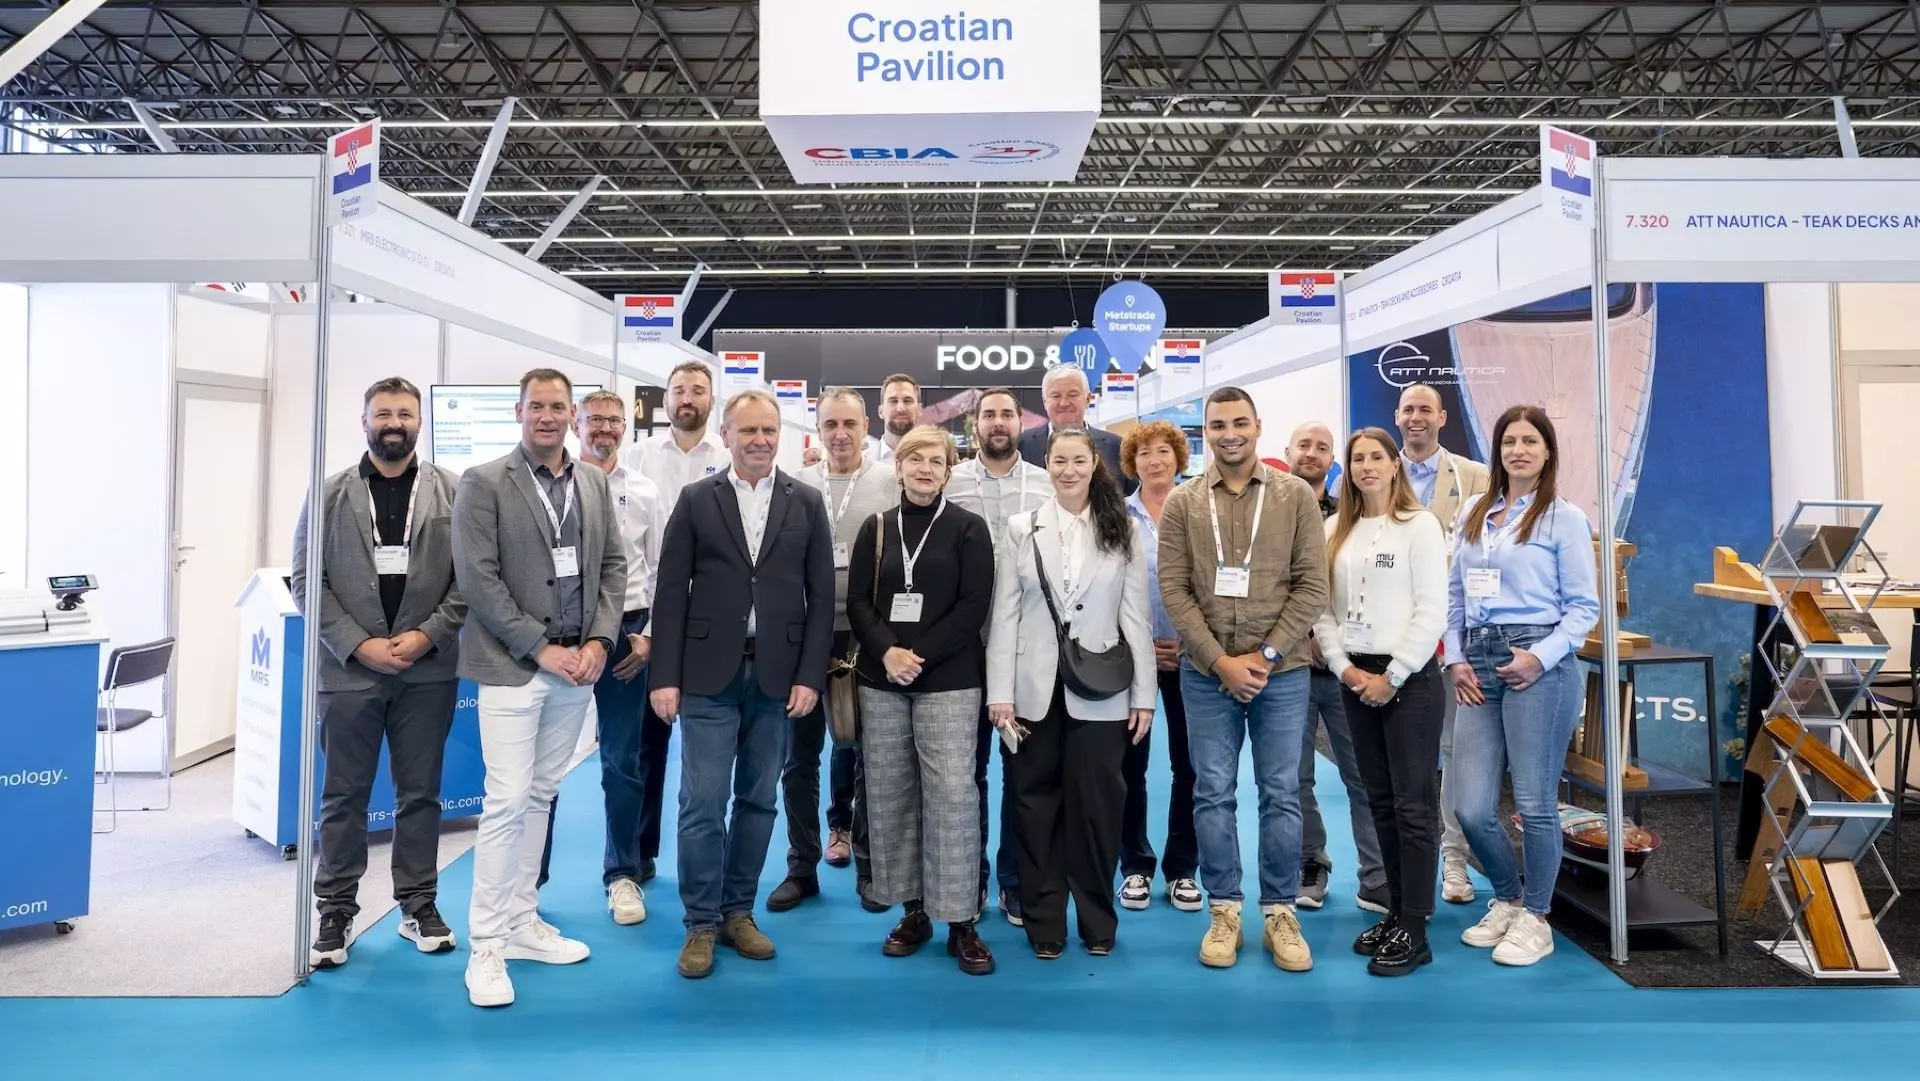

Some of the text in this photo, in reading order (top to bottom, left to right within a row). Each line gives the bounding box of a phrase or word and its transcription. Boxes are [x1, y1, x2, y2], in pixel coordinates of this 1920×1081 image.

[848, 11, 1013, 43] Croatian
[857, 50, 1004, 83] Pavilion
[804, 147, 960, 160] CBIA
[340, 195, 362, 209] Croatian
[1560, 196, 1583, 210] Croatian
[341, 207, 360, 220] Pavilion
[1562, 208, 1583, 221] Pavilion
[1626, 215, 1669, 228] 7.320
[1686, 215, 1714, 228] ATT
[1717, 215, 1788, 228] NAUTICA
[1803, 215, 1843, 228] TEAK
[1846, 215, 1900, 228] DECKS
[360, 229, 375, 247] MRS
[1441, 270, 1462, 287] CROATIA
[1104, 310, 1156, 320] Metstrade
[1108, 321, 1152, 333] Startups
[936, 344, 1035, 371] FOOD
[1389, 366, 1506, 376] ATT NAUTICA
[250, 669, 270, 687] MRS
[2, 900, 48, 918] .com
